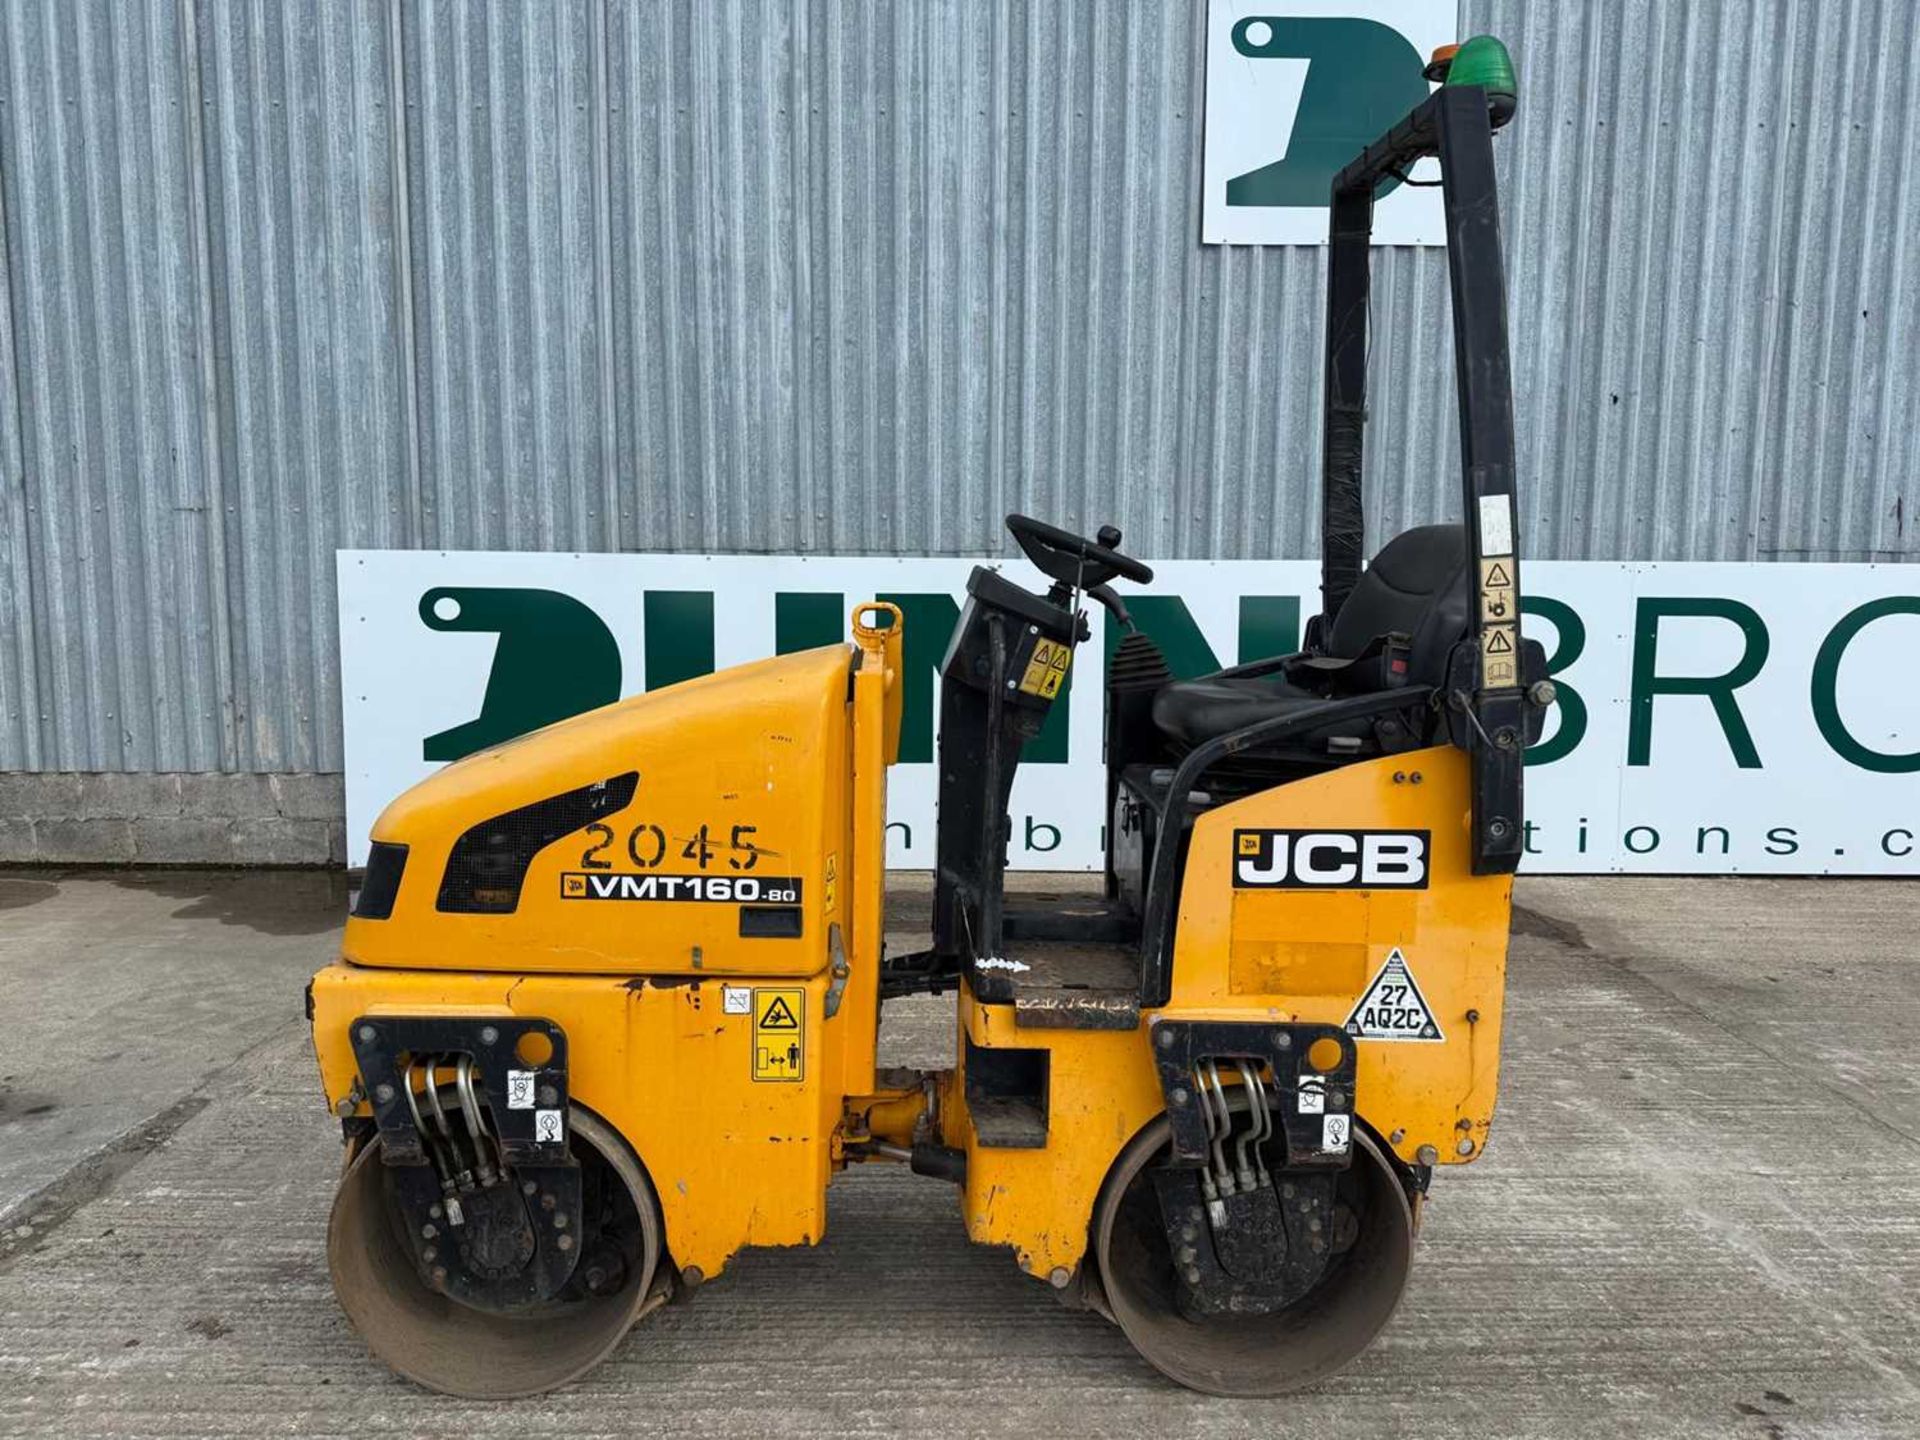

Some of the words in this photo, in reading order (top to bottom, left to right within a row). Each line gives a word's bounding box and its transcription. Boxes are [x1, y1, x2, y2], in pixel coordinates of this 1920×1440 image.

[581, 823, 759, 870] 2045
[1238, 834, 1425, 884] JCB
[1379, 984, 1408, 1006] 27
[1362, 1007, 1421, 1030] AQ2C
